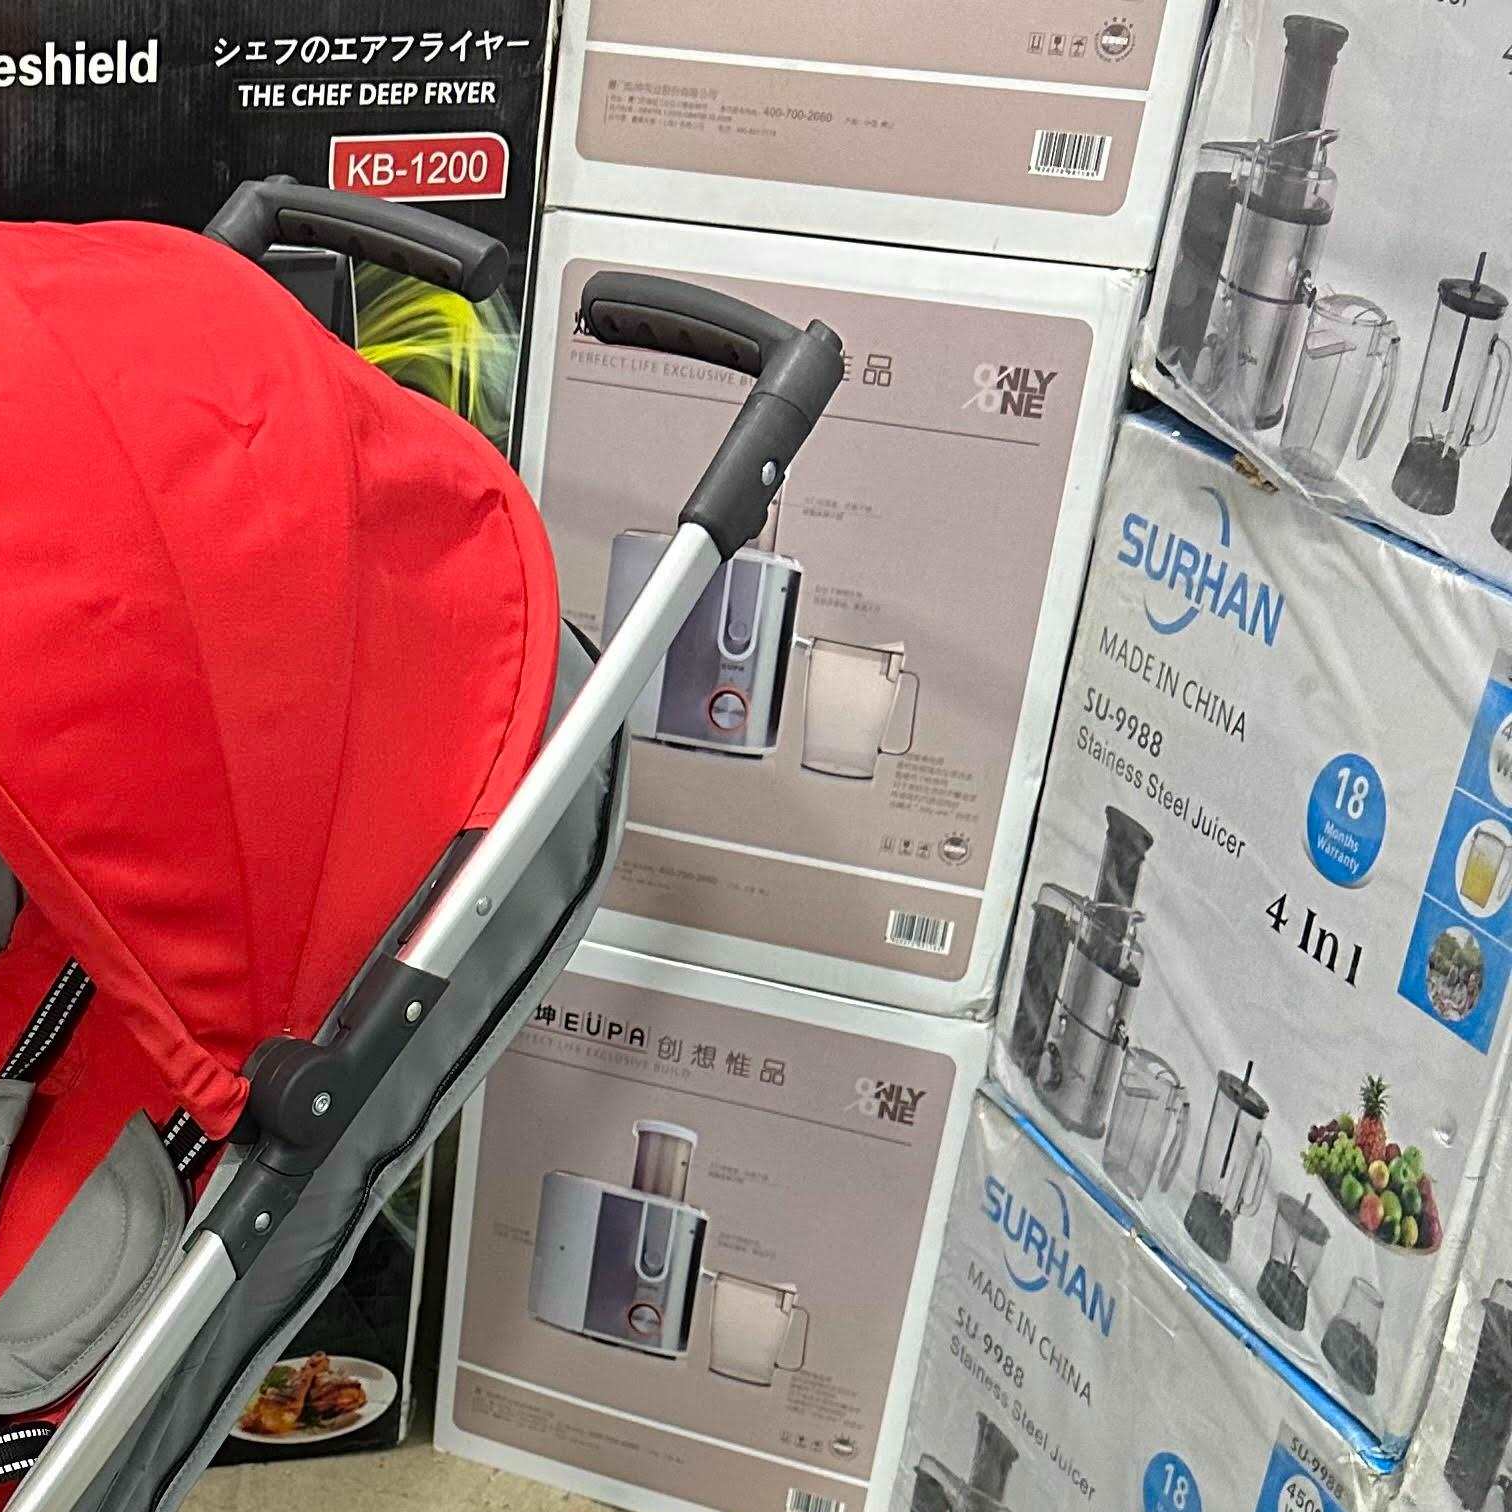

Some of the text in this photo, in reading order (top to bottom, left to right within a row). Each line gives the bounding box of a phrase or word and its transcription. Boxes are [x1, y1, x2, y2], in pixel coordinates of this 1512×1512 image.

[214, 30, 530, 68] シェフのエアフライヤー
[238, 81, 496, 108] THE CHEF DEEP FRYER
[346, 149, 488, 187] KB-1200
[630, 357, 658, 375] LIFE
[663, 361, 736, 386] EXCLUSIVE
[1116, 511, 1285, 649] SURHAN
[1098, 626, 1246, 743] MADE IN CHINA
[1083, 686, 1163, 759] SU-9988
[1076, 724, 1246, 859] Stainess Steel Juicer
[1335, 766, 1370, 820] 18
[1316, 836, 1361, 876] Warranty
[1322, 819, 1362, 853] Months
[1265, 893, 1290, 934] 4
[980, 1174, 1117, 1338] SURHAN
[966, 1260, 1092, 1407] MADE IN CHINA
[1012, 1399, 1049, 1451] Steel
[1049, 1443, 1097, 1502] Juicer
[1161, 1463, 1190, 1511] 18
